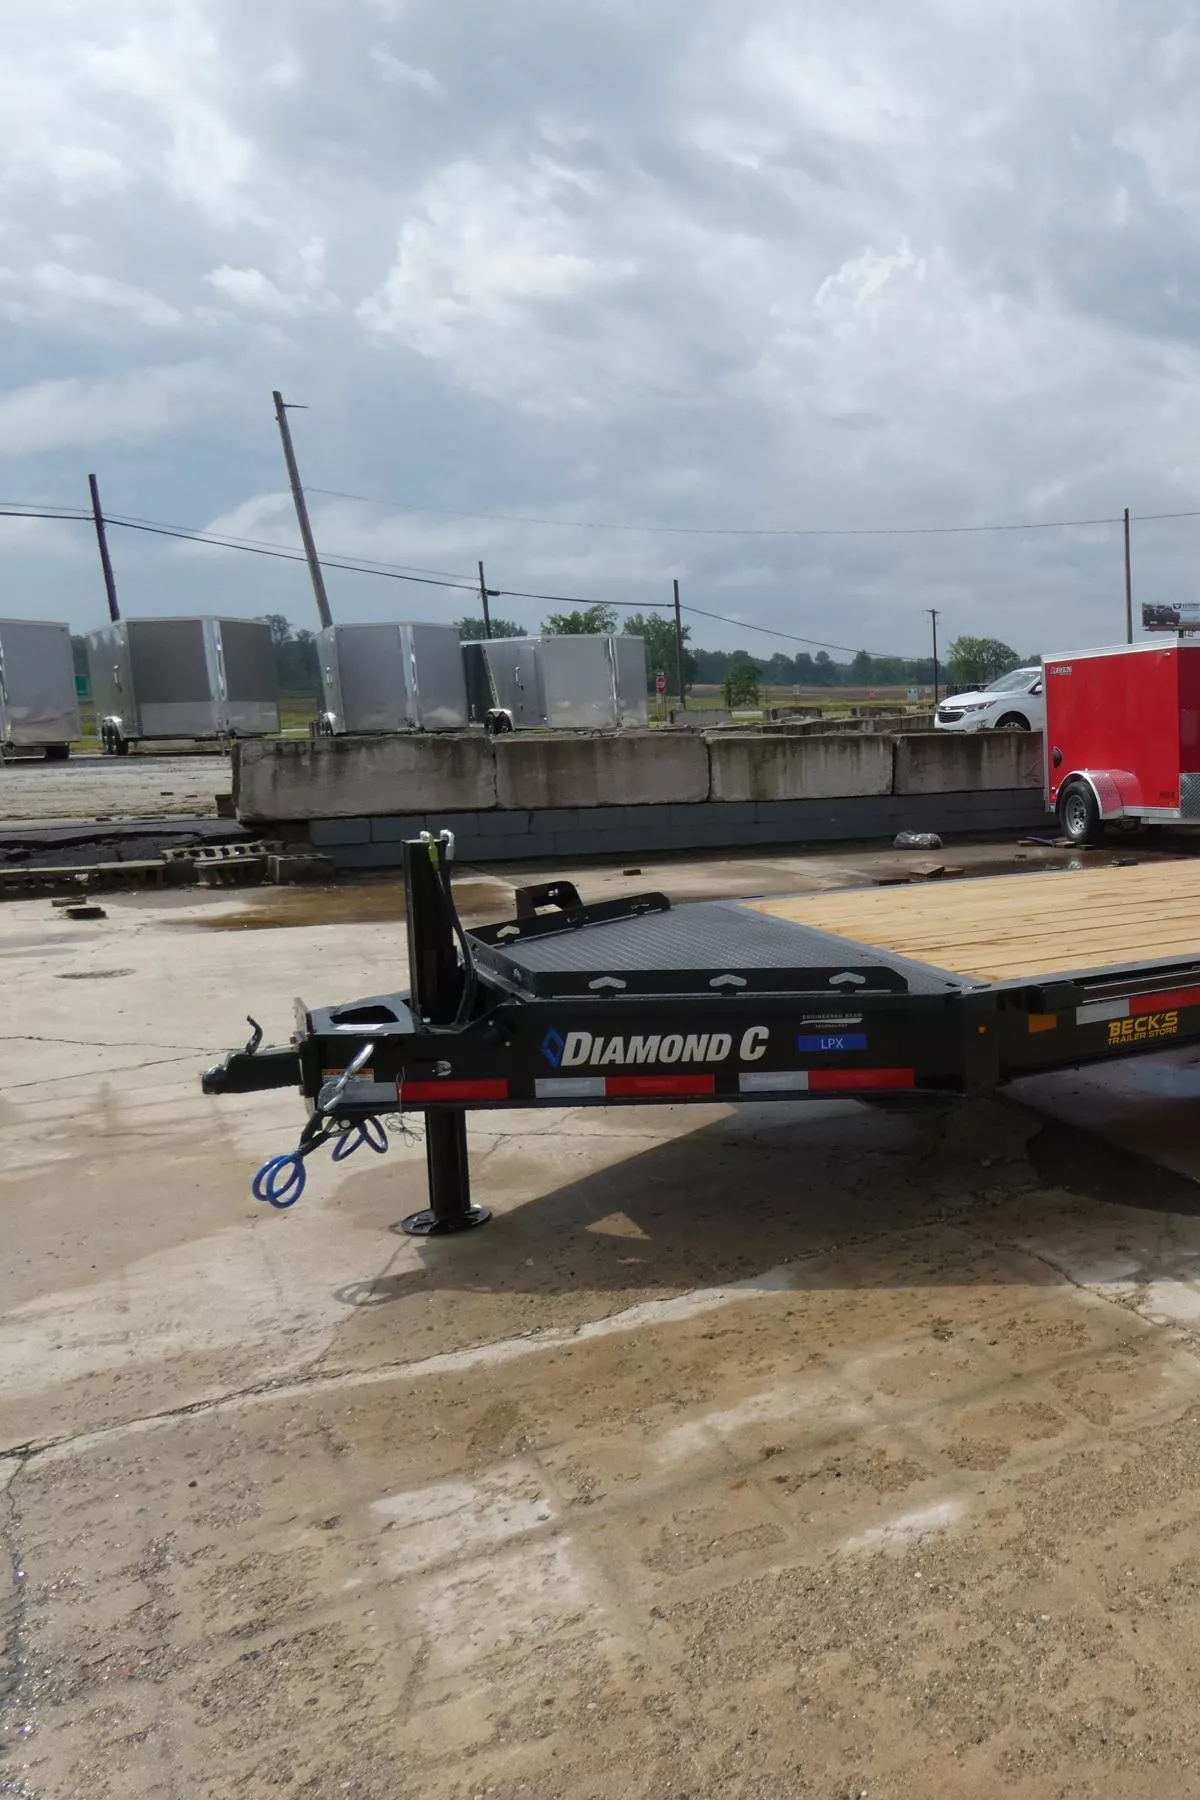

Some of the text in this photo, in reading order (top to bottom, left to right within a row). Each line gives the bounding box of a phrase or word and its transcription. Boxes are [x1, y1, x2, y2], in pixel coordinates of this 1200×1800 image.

[1107, 1025, 1178, 1047] TRAILER STORE
[1108, 1011, 1179, 1038] BECK'S
[560, 1025, 770, 1067] DIAMOND C
[821, 1037, 844, 1050] LPX
